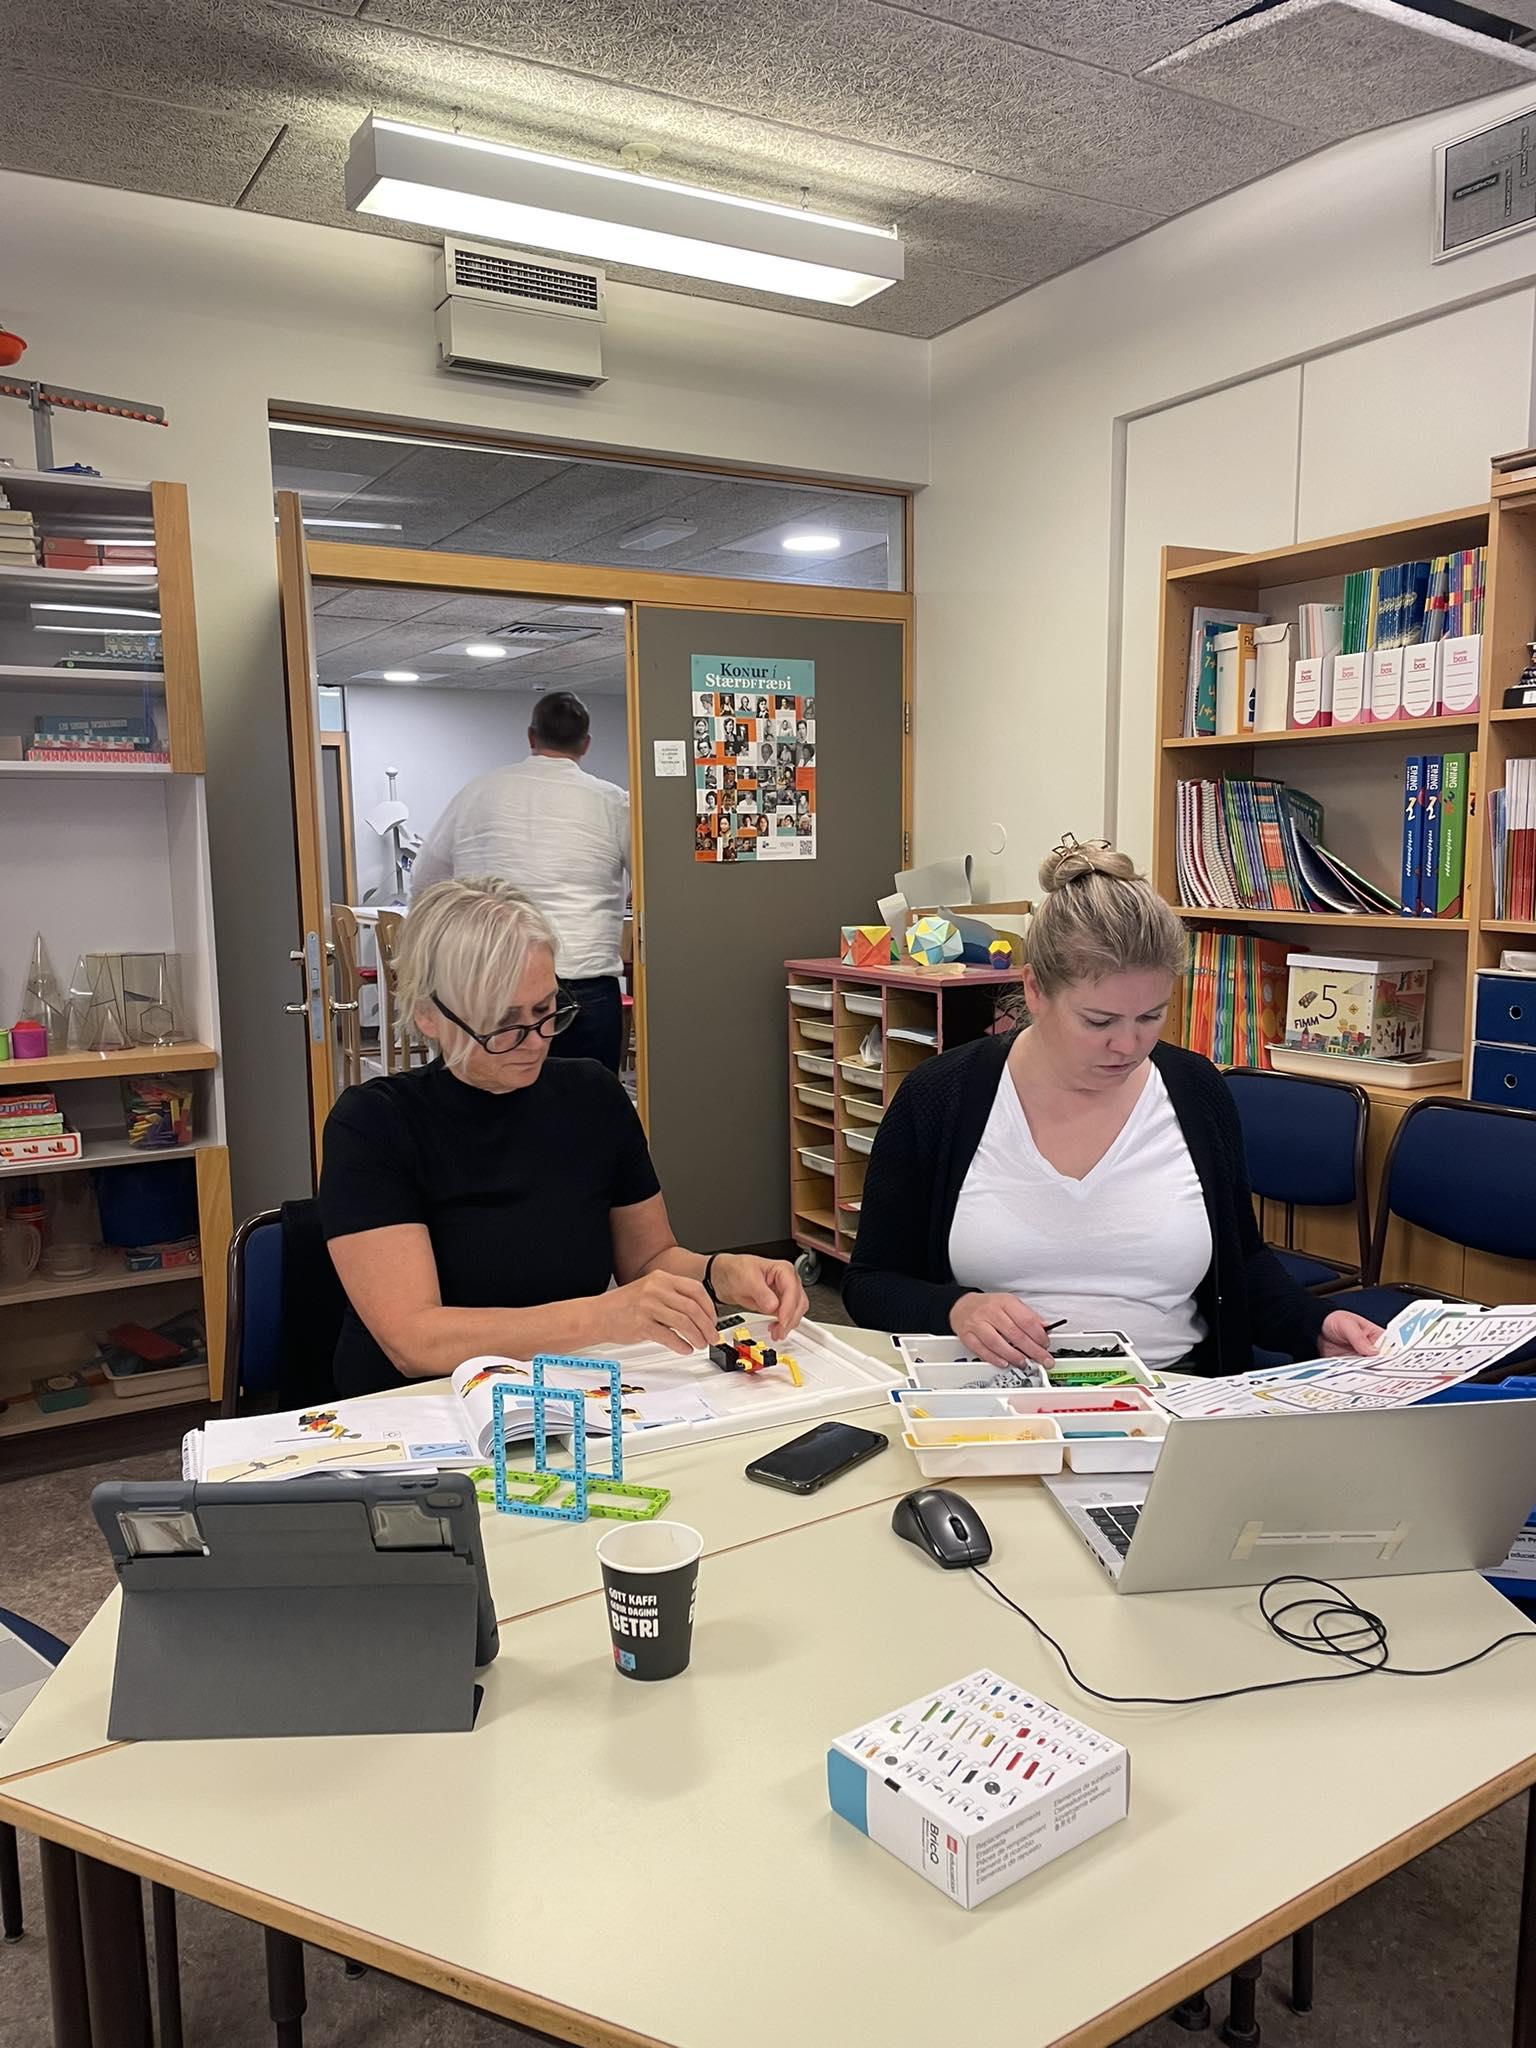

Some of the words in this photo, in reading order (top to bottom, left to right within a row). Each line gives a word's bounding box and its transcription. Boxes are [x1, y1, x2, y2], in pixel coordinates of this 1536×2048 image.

[1409, 765, 1419, 791] EINING
[1430, 764, 1439, 791] EINING
[1449, 761, 1459, 789] EINING
[1318, 984, 1338, 1020] 5
[1294, 1015, 1320, 1030] FIMM
[609, 1587, 626, 1604] GOTT
[628, 1594, 658, 1607] KAFFI
[611, 1610, 659, 1638] BETRI
[627, 1607, 658, 1617] DAGINN
